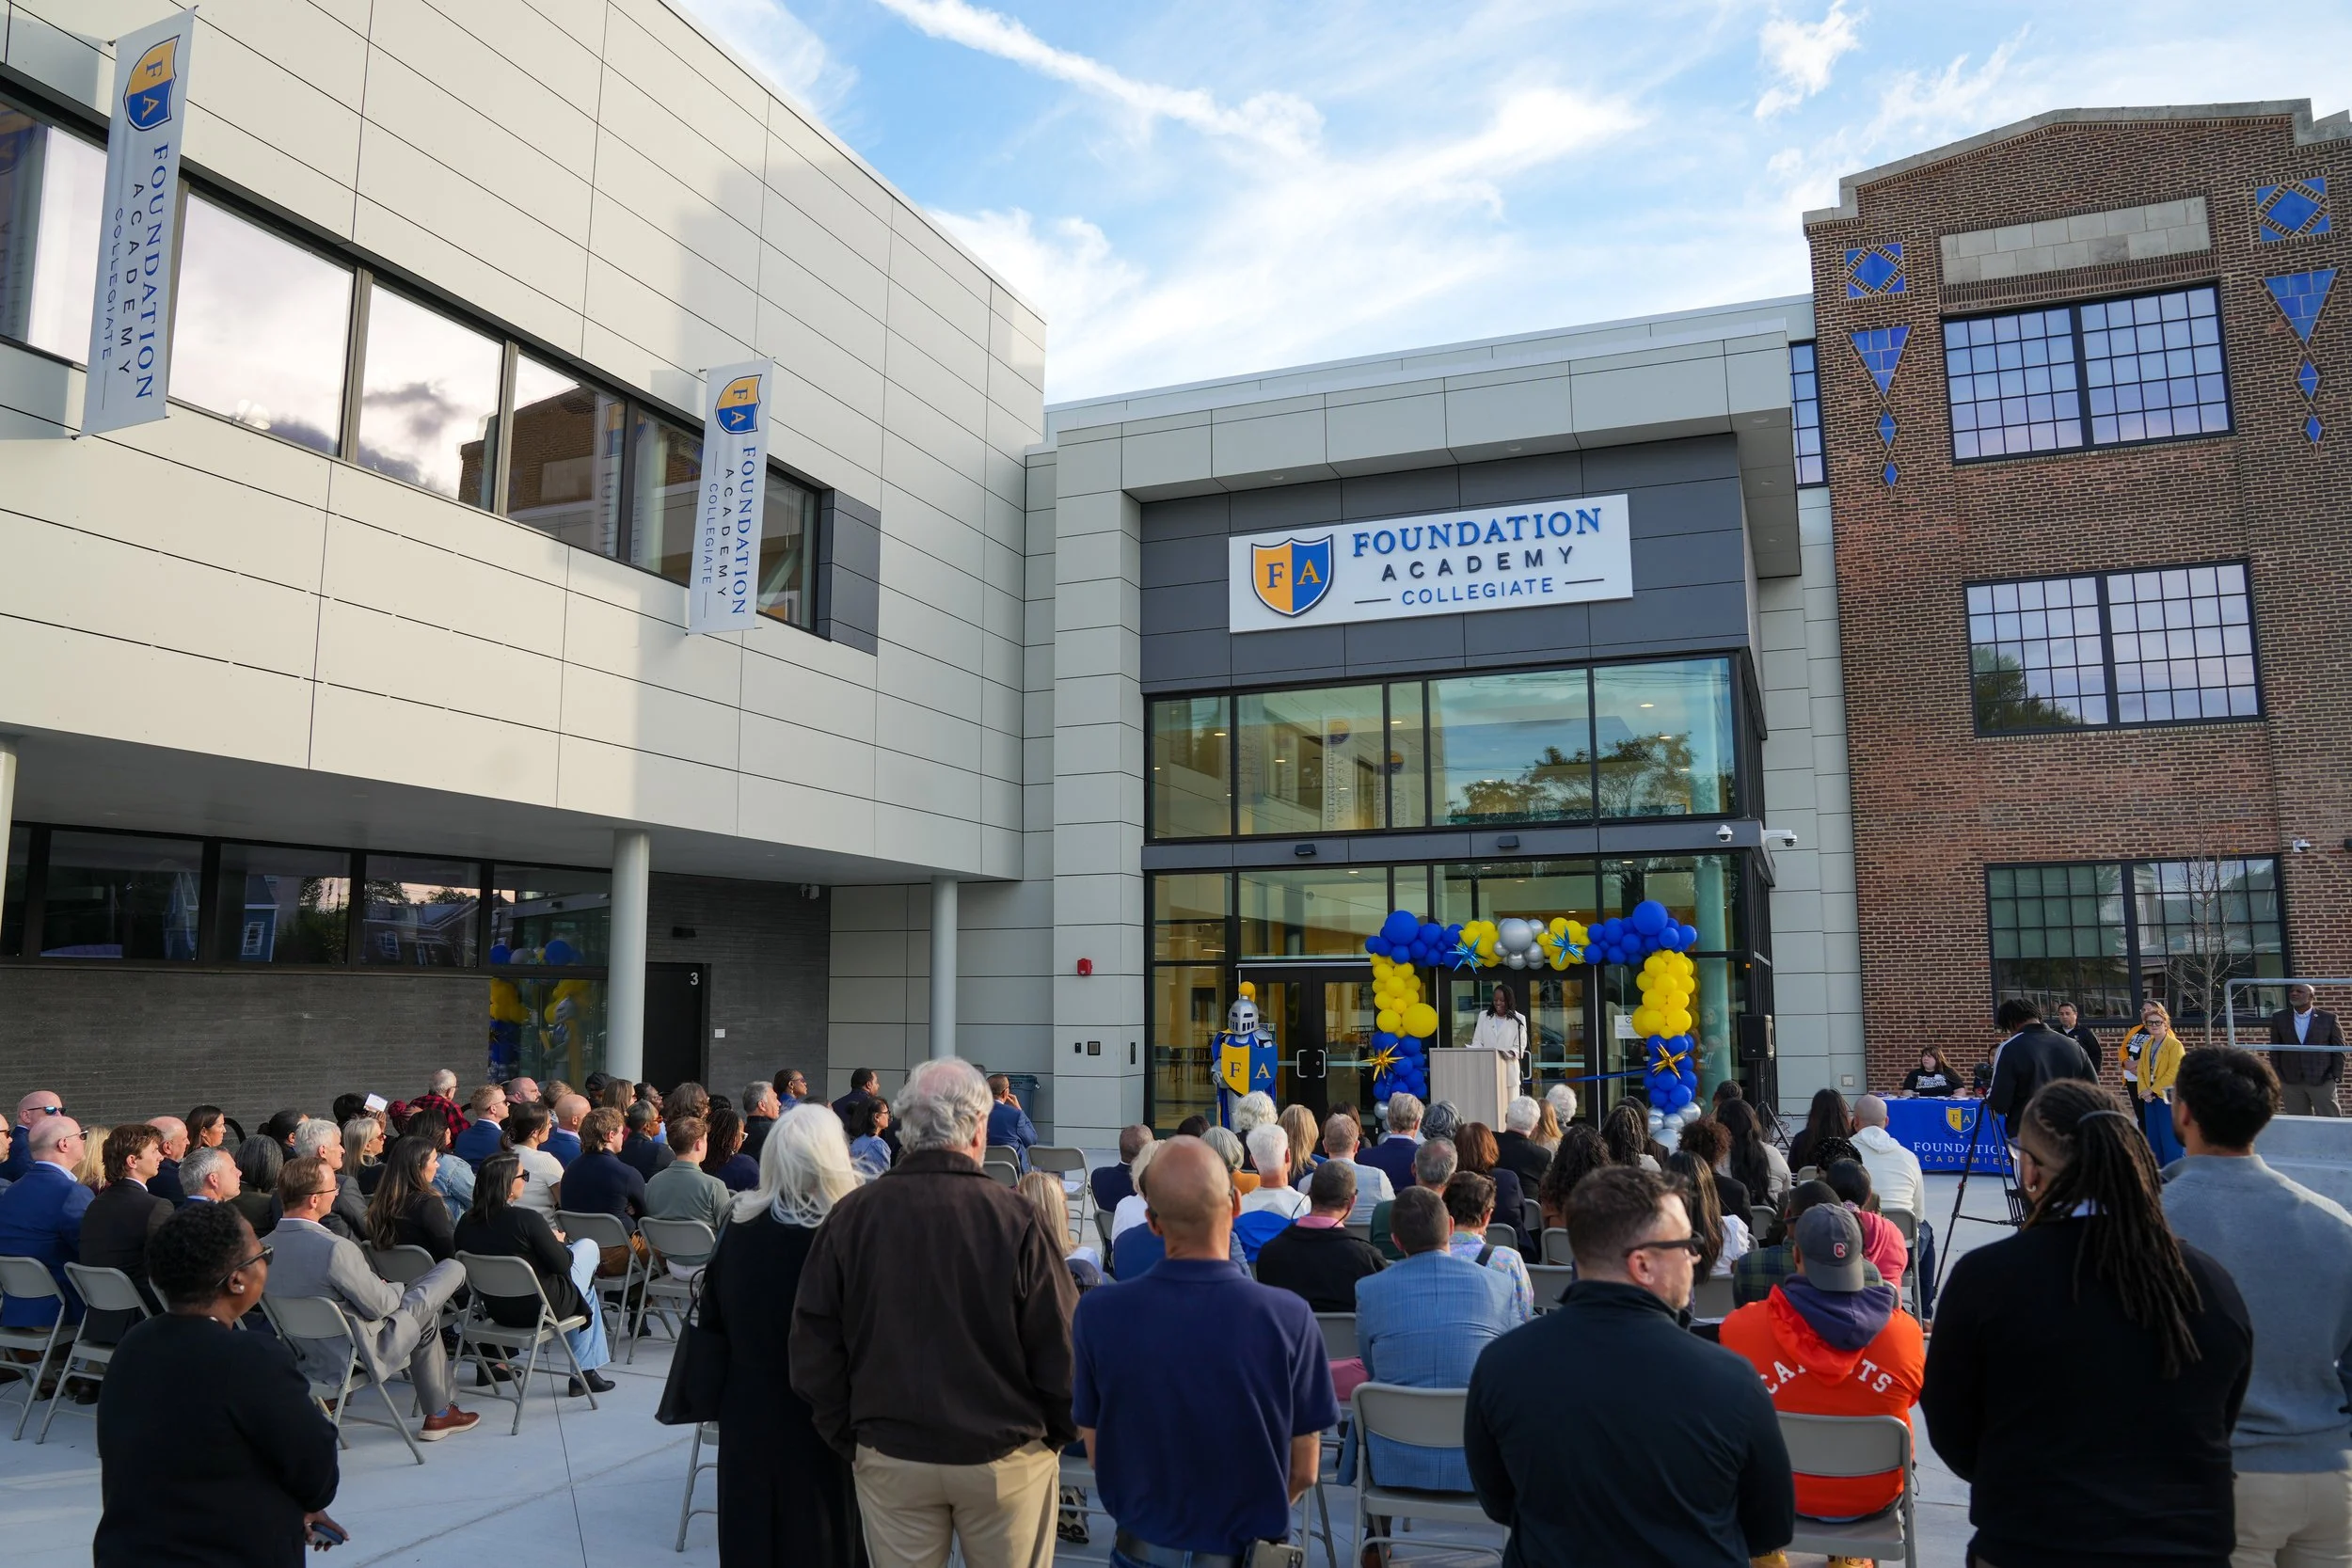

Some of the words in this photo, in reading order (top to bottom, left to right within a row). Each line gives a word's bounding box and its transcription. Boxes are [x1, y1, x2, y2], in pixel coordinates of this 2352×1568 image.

[102, 207, 123, 360] COLLEGIATE
[119, 182, 145, 374] ACADEMY
[136, 141, 169, 399] FOUNDATION
[702, 483, 718, 584] COLLEGIATE
[717, 468, 734, 596] ACADEMY
[732, 446, 756, 615] FOUNDATION
[1352, 507, 1602, 558] FOUNDATION
[1381, 545, 1574, 582] ACADEMY
[1402, 577, 1554, 606] COLLEGIATE
[690, 972, 699, 986] 3
[1915, 1154, 2011, 1166] CADEMIES
[1834, 1242, 1846, 1259] C
